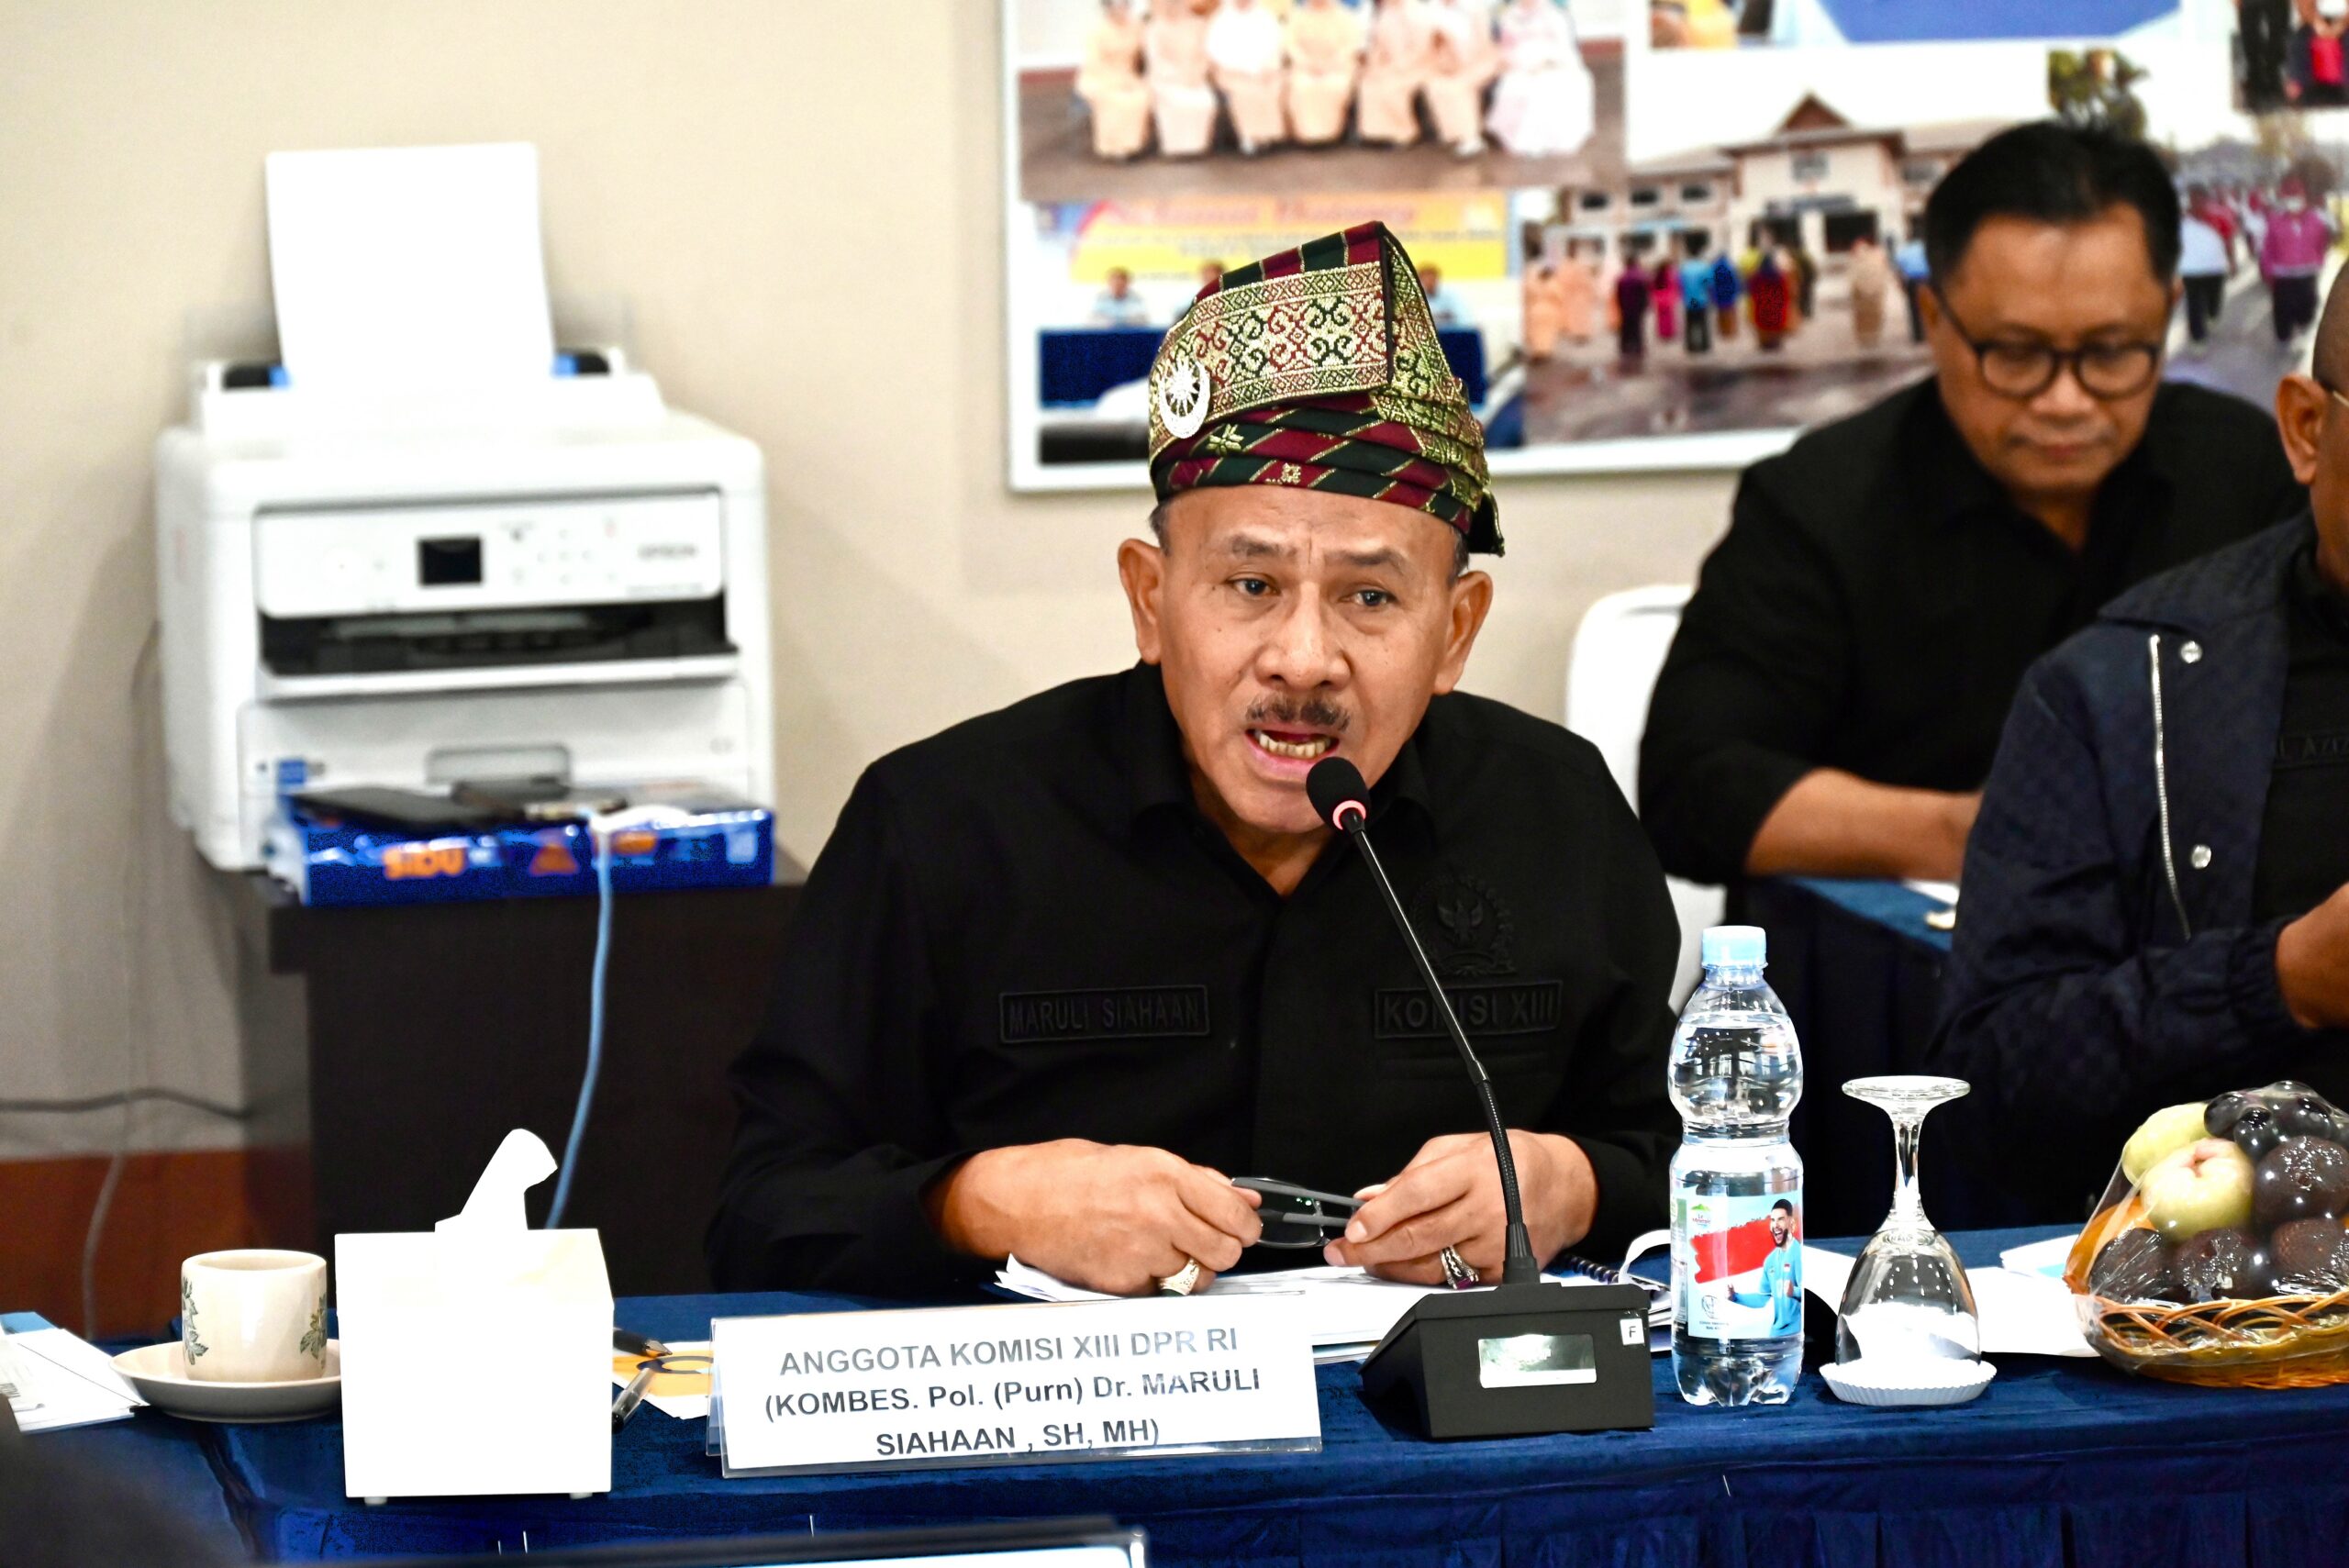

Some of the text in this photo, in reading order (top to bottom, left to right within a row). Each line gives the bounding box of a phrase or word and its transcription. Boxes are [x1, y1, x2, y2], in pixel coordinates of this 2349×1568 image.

[1008, 994, 1198, 1036] MARULI SIAHAAN
[1510, 989, 1554, 1025] XIII
[780, 1328, 1237, 1375] ANGGOTA KOMISI XIII DPR RI
[1629, 1326, 1637, 1339] F
[765, 1368, 1259, 1423] (KOMBES. Pol. (Purn) Dr. MARULI
[876, 1427, 1016, 1456] SIAHAAN
[1043, 1423, 1094, 1450] SH,
[1103, 1418, 1160, 1447] MH)
